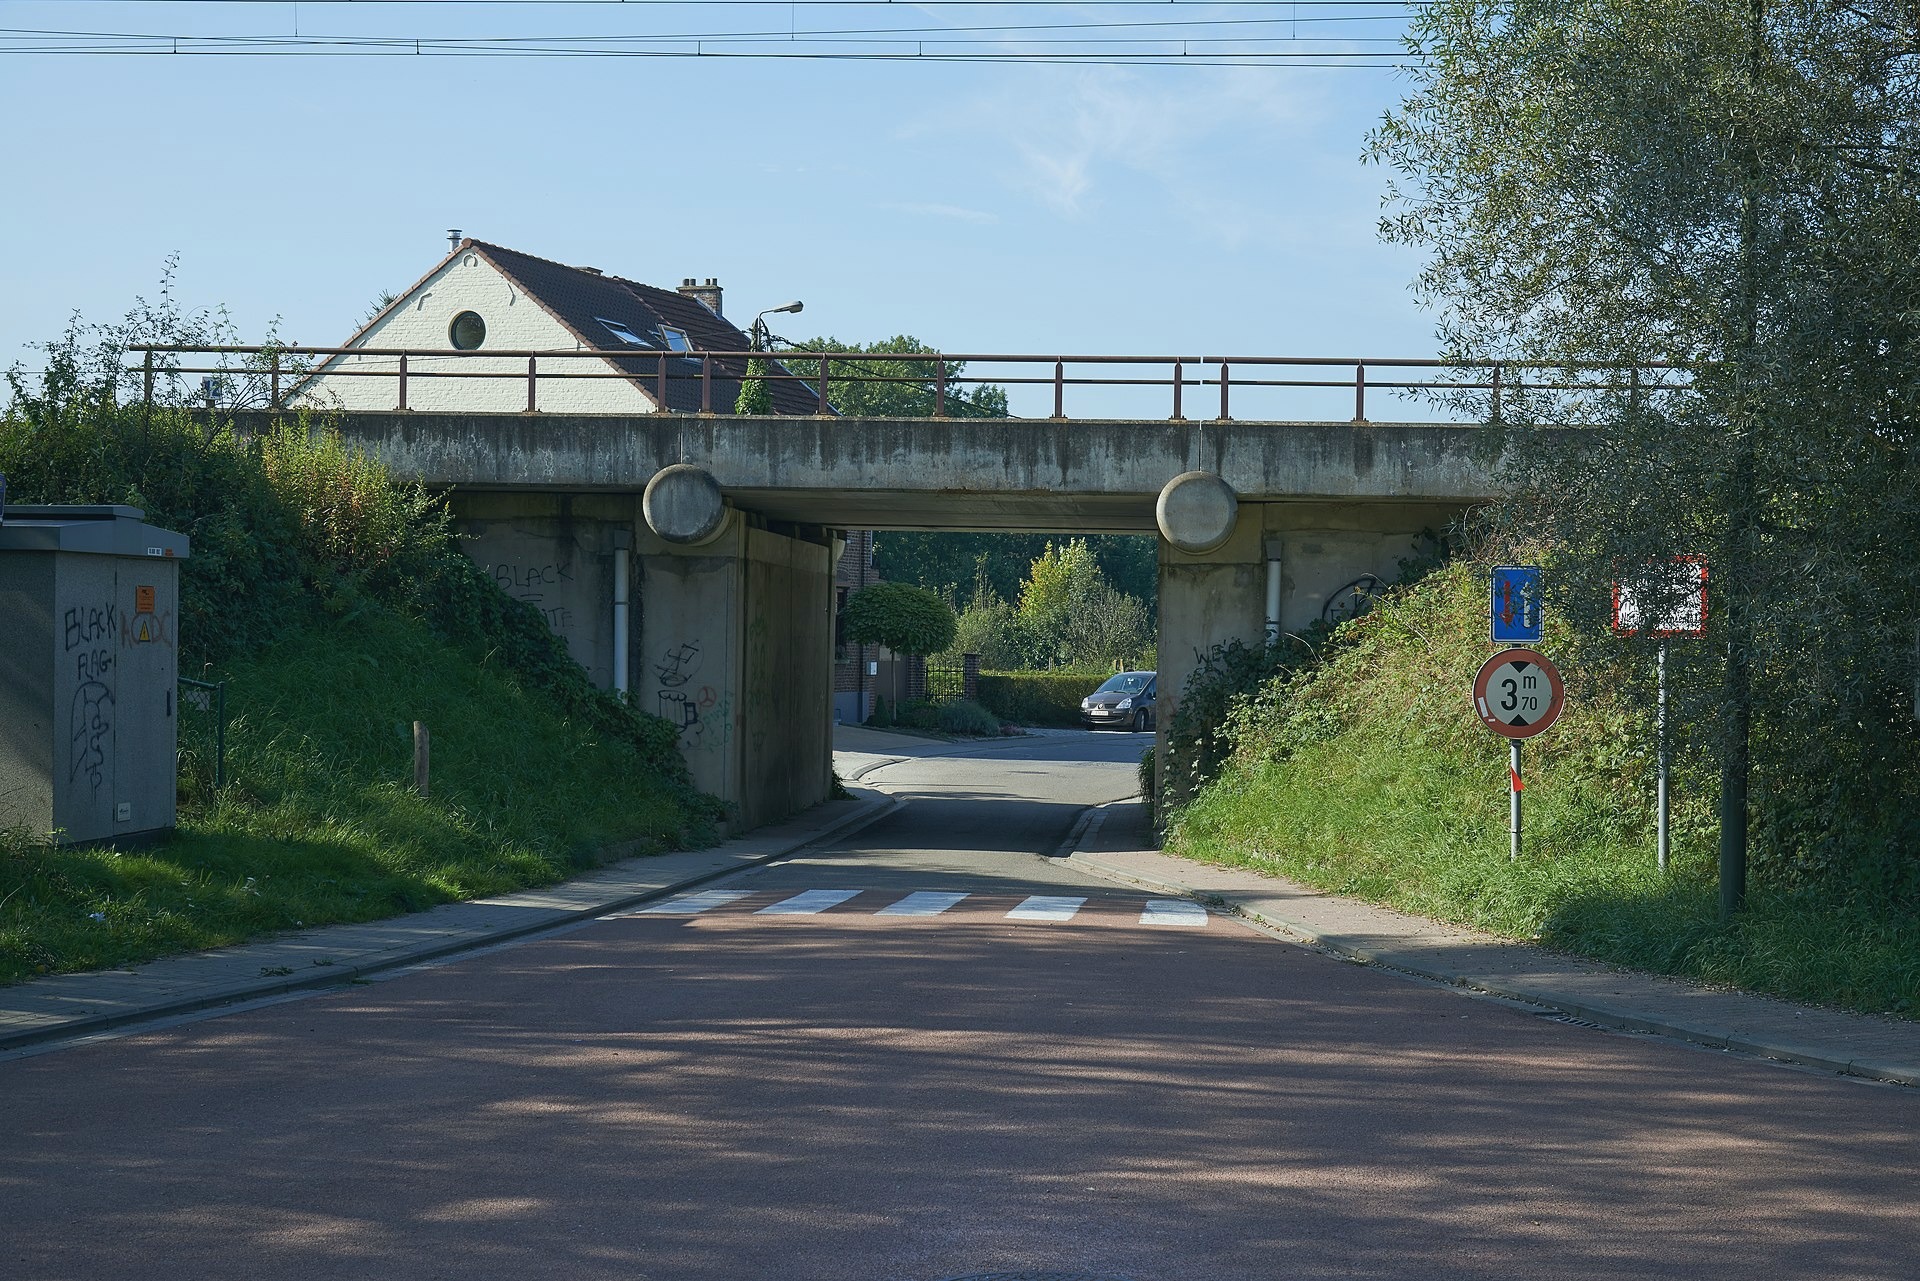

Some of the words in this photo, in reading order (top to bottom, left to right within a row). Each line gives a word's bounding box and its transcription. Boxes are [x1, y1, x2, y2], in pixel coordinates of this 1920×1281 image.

[496, 562, 574, 590] BLACK
[65, 602, 116, 652] BLACK
[78, 649, 112, 680] FLAG
[1522, 697, 1538, 711] 70
